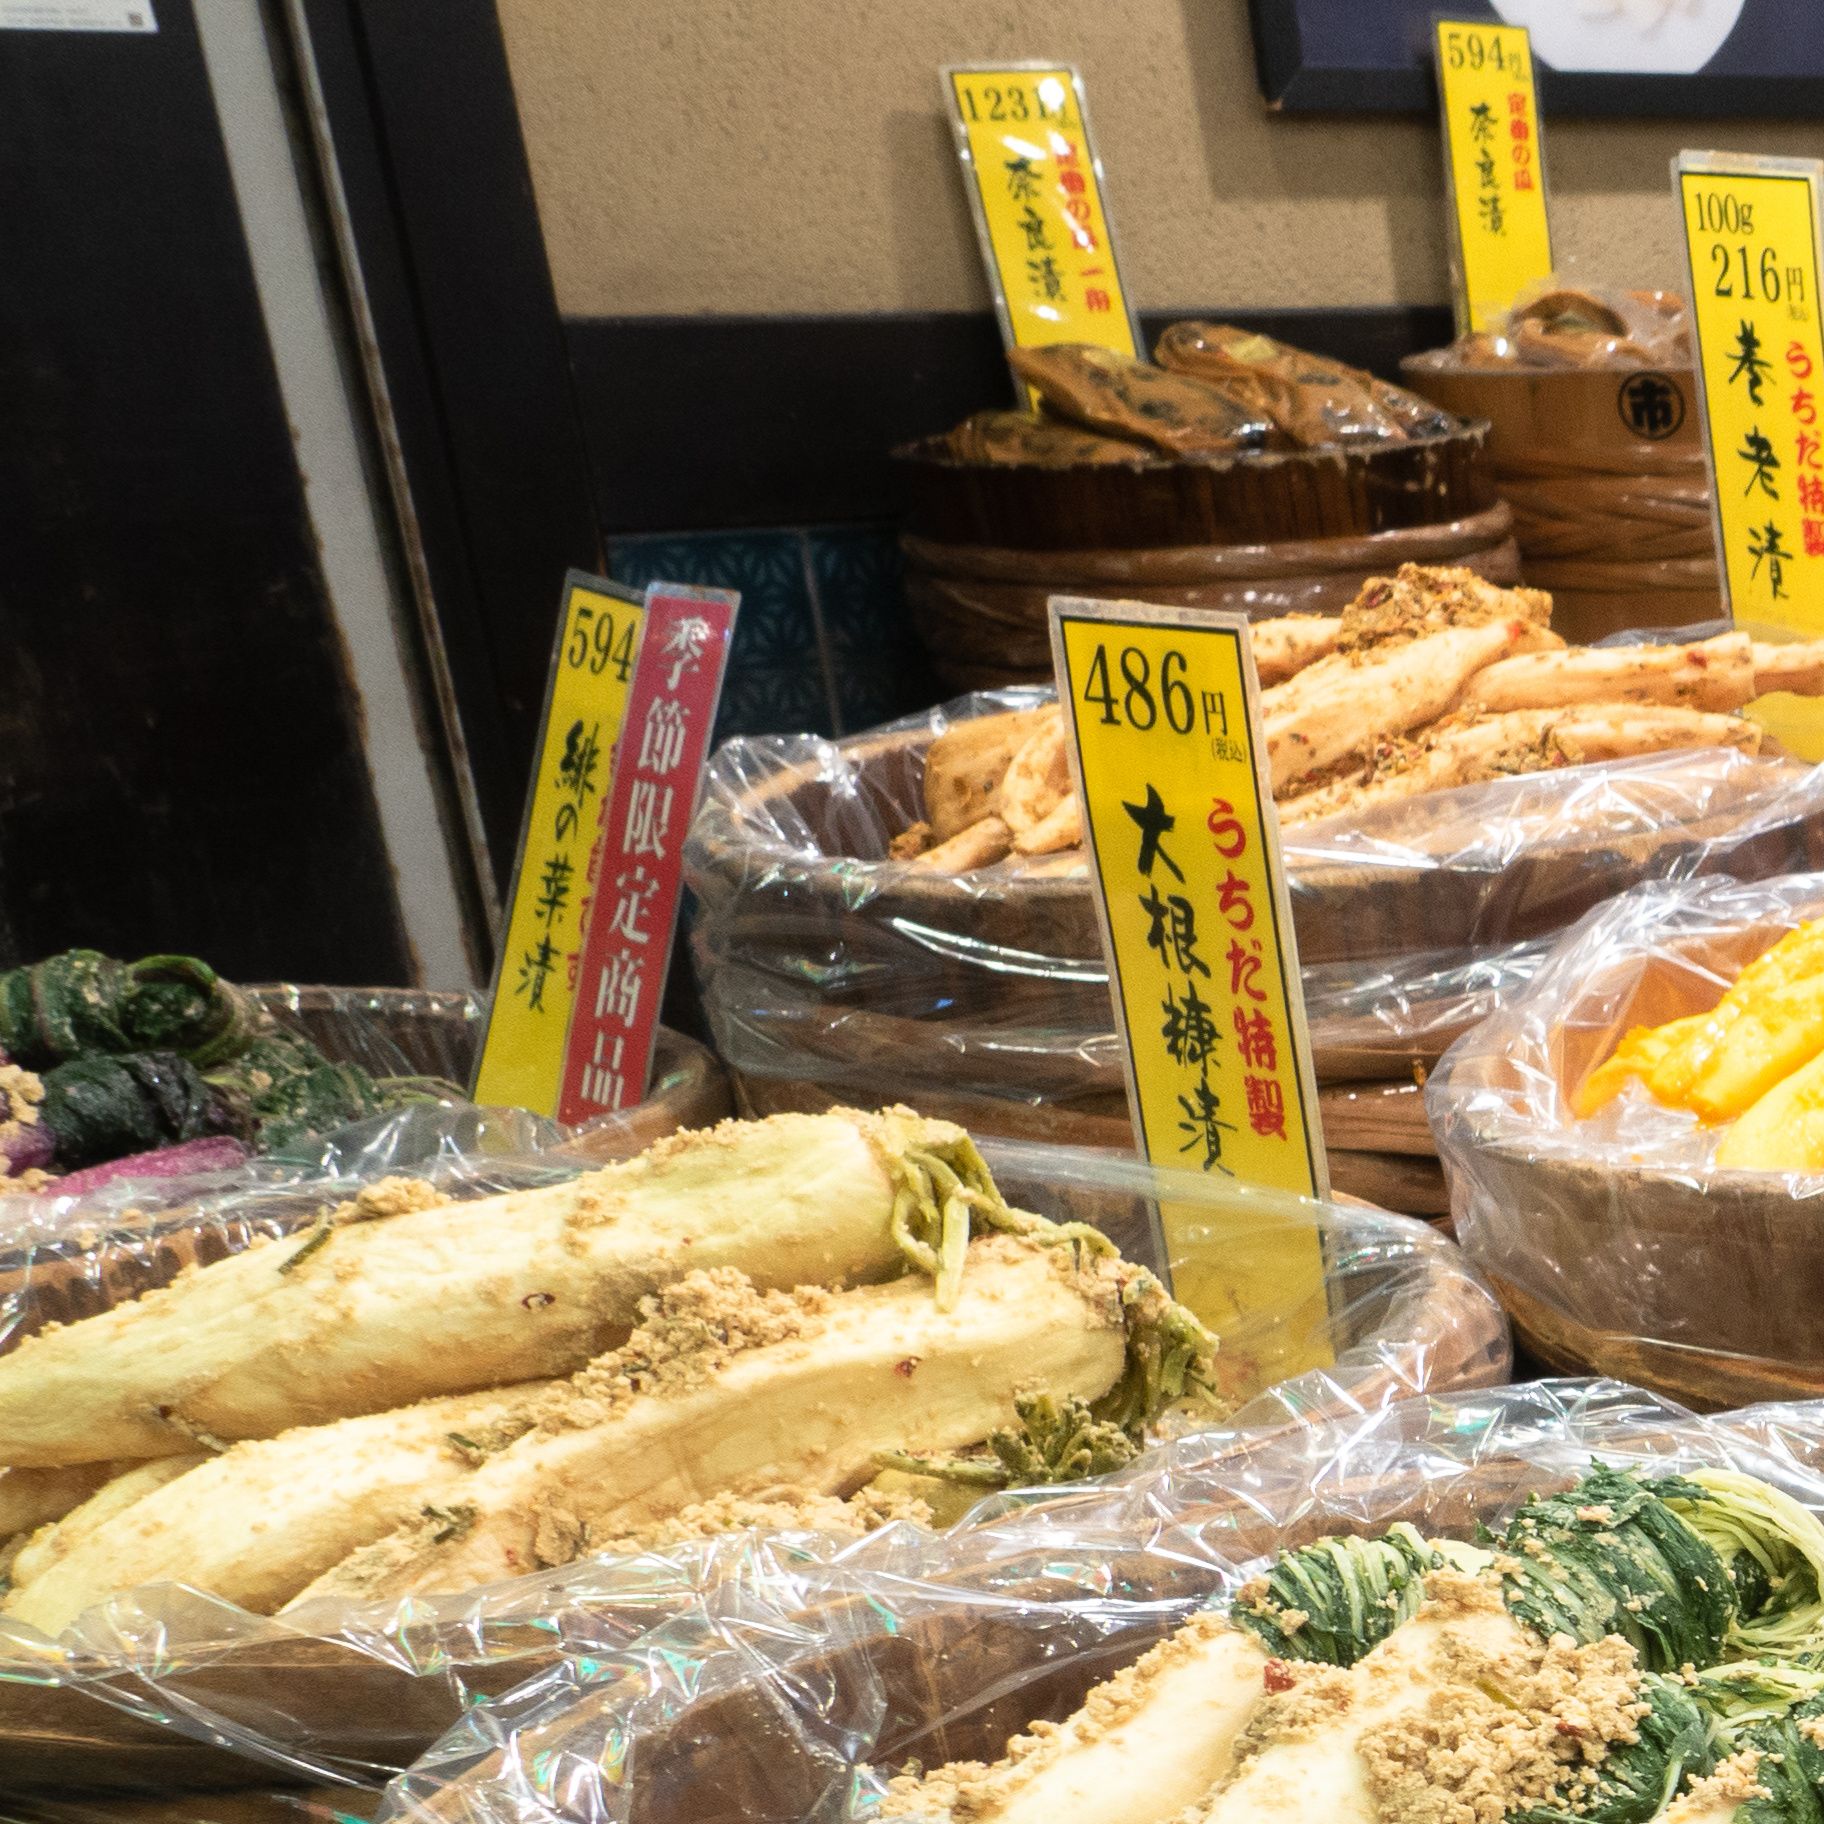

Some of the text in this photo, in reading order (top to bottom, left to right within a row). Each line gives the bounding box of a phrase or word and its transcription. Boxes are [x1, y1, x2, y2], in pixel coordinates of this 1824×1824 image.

[964, 86, 1060, 122] 1231
[1695, 192, 1755, 235] 100g
[1711, 243, 1805, 303] 216円
[567, 605, 637, 684] 594
[1083, 643, 1228, 737] 486円
[1211, 737, 1247, 764] (税込)
[580, 614, 713, 1111] 季節限定商品
[1121, 782, 1238, 1178] 大根糠漬
[1206, 798, 1288, 1142] うちだ特製
